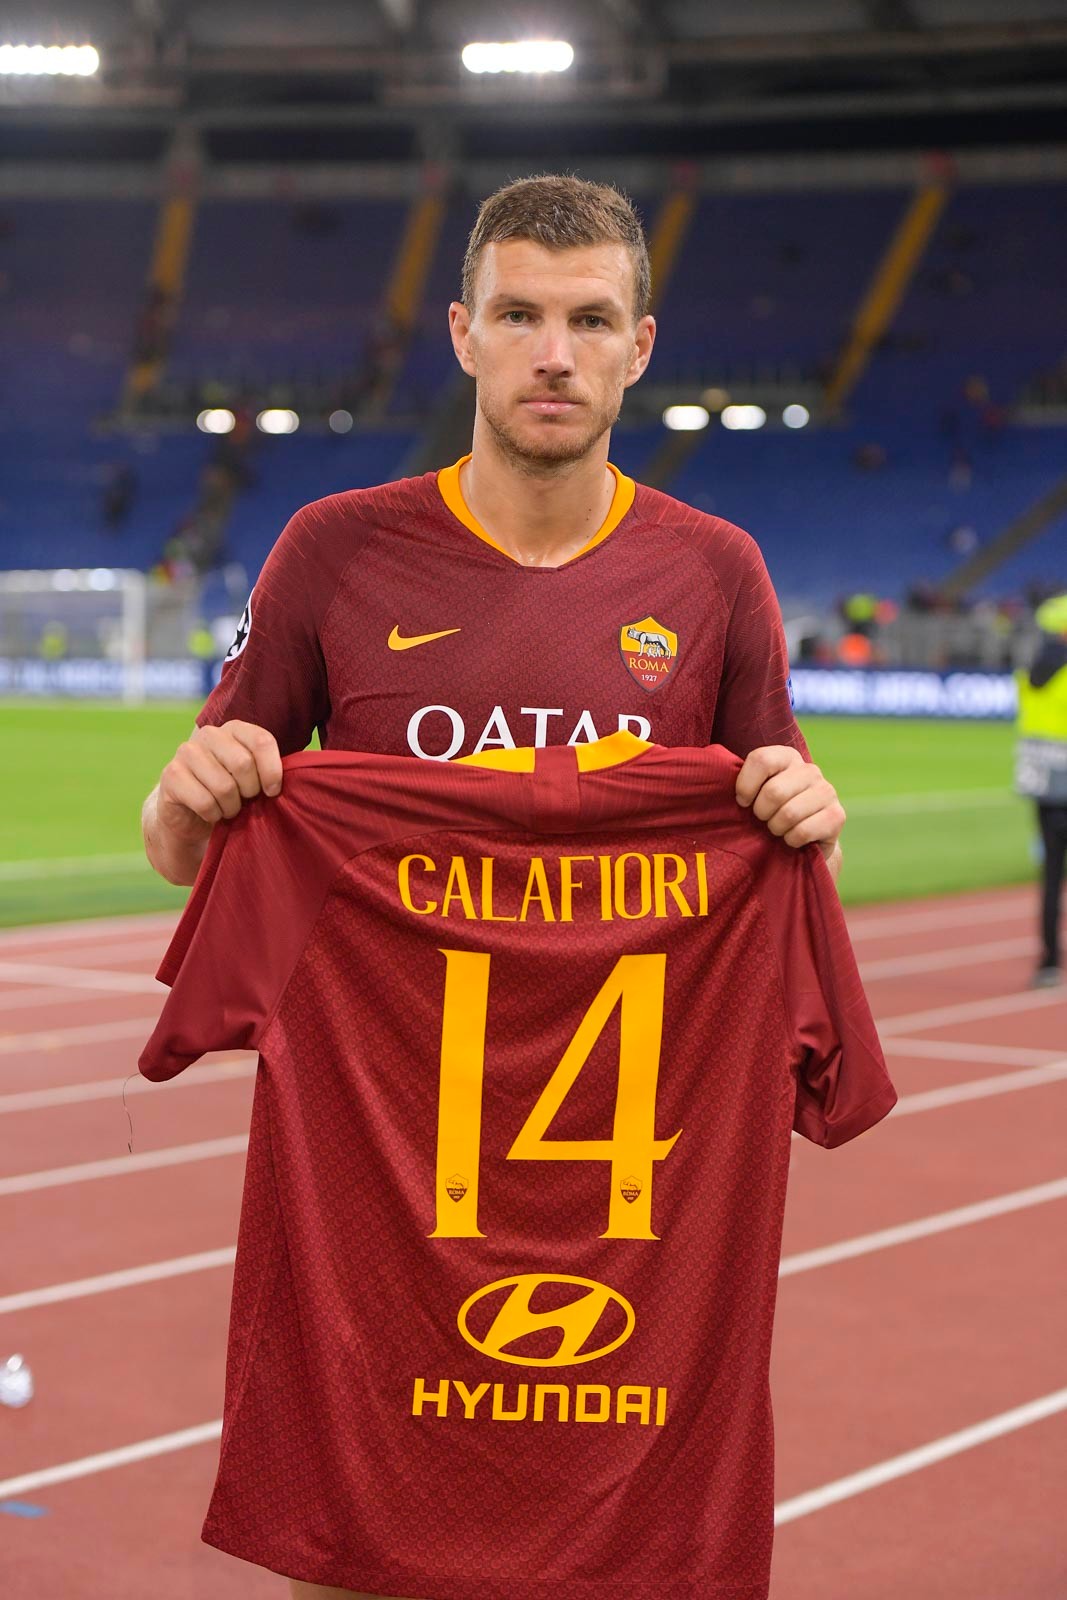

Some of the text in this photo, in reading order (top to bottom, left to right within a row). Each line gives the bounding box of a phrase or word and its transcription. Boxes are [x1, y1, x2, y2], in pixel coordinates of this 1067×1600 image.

[629, 657, 670, 673] ROMA
[641, 674, 658, 682] 1927
[398, 852, 709, 923] CALAFIORI
[427, 949, 683, 1241] 14
[412, 1377, 668, 1426] HYUNDAI
